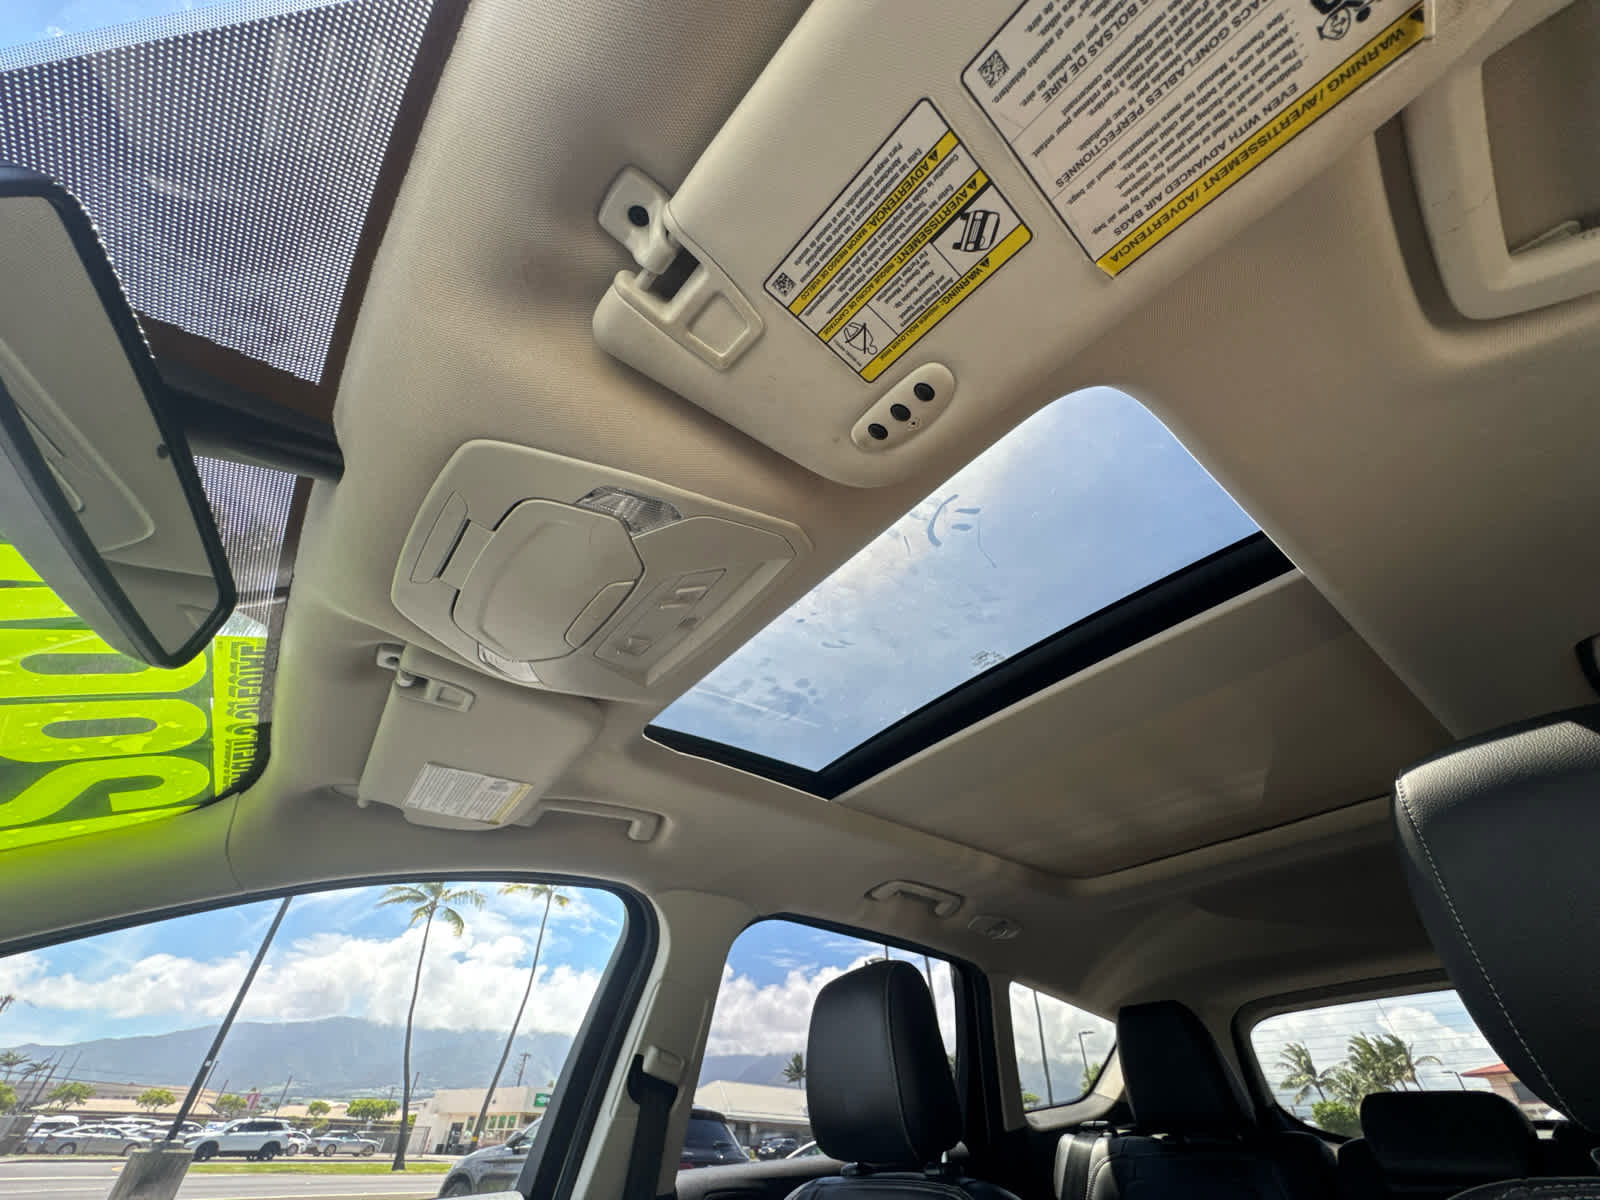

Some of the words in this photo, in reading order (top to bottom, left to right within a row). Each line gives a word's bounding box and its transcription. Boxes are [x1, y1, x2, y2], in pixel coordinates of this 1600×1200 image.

[1087, 2, 1139, 57] BOLSAS
[1069, 53, 1087, 75] DE
[1145, 24, 1230, 106] GONFLABLES
[1327, 25, 1404, 93] WARNING
[1040, 72, 1069, 104] AIRE
[1262, 82, 1299, 116] EVEN
[1054, 103, 1144, 188] PERFECTIONNÉS
[1203, 89, 1324, 189] /AVERTISSEMENT
[1228, 113, 1260, 143] WITH
[866, 160, 929, 229] ADVERTENCIA:
[1164, 141, 1227, 195] ADVANCED
[894, 187, 969, 263] AVERTISSEMENT:
[1109, 189, 1199, 263] /ADVERTENCIA
[1112, 209, 1143, 236] BAGS
[1144, 192, 1163, 211] AIR
[939, 266, 981, 305] WARNING:
